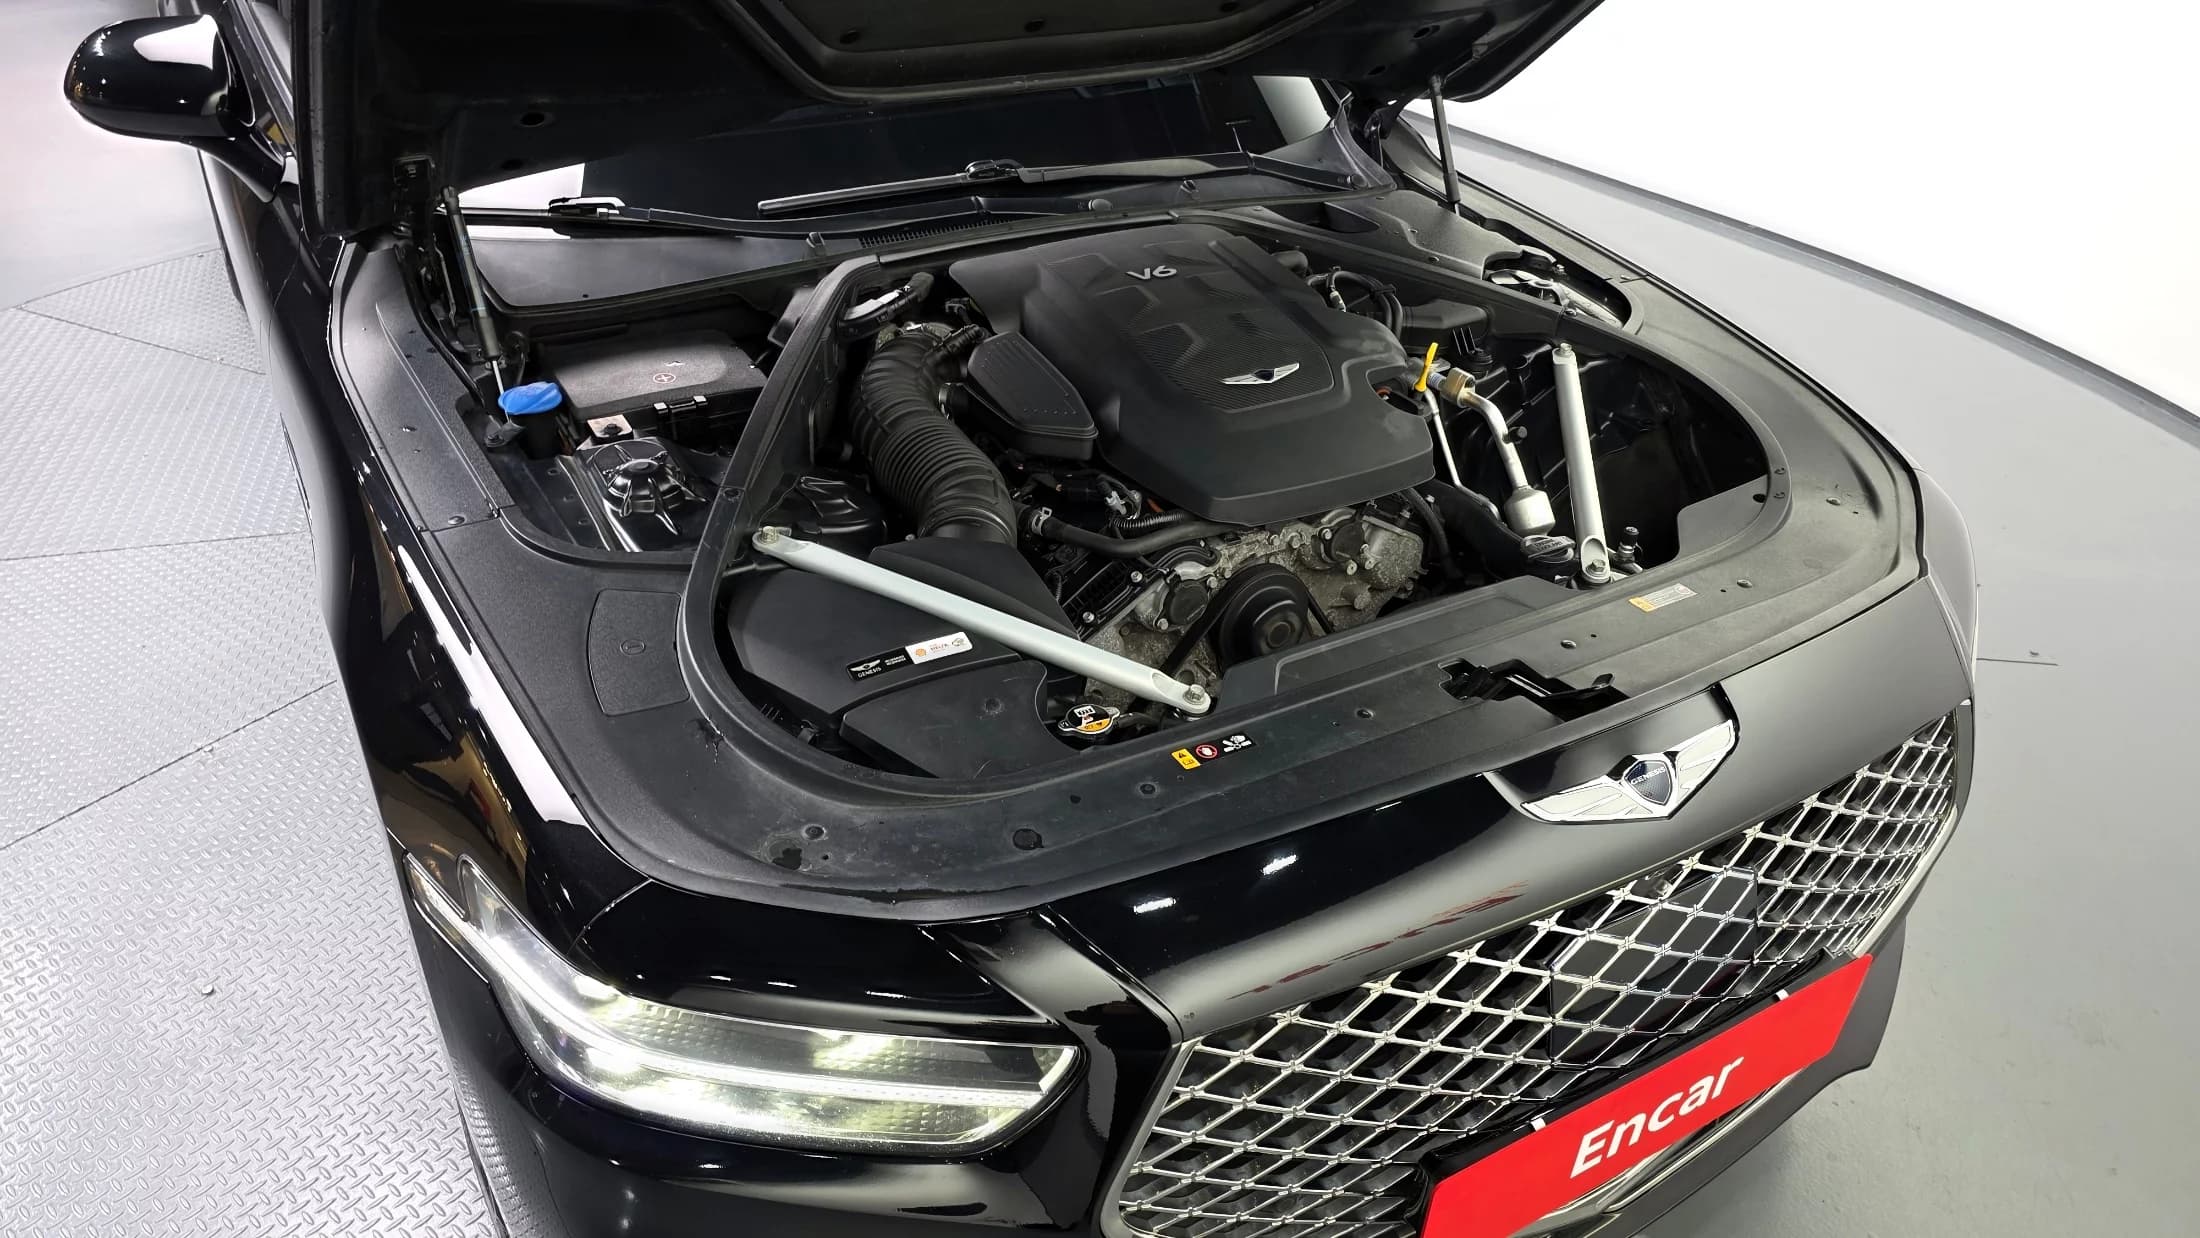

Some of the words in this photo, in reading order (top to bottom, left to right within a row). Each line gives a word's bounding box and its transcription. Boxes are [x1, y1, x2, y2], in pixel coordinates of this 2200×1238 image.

[1126, 265, 1177, 280] V6
[858, 667, 882, 678] GENESIS
[1630, 766, 1666, 785] GENESIS
[1570, 1056, 1744, 1179] Encar
